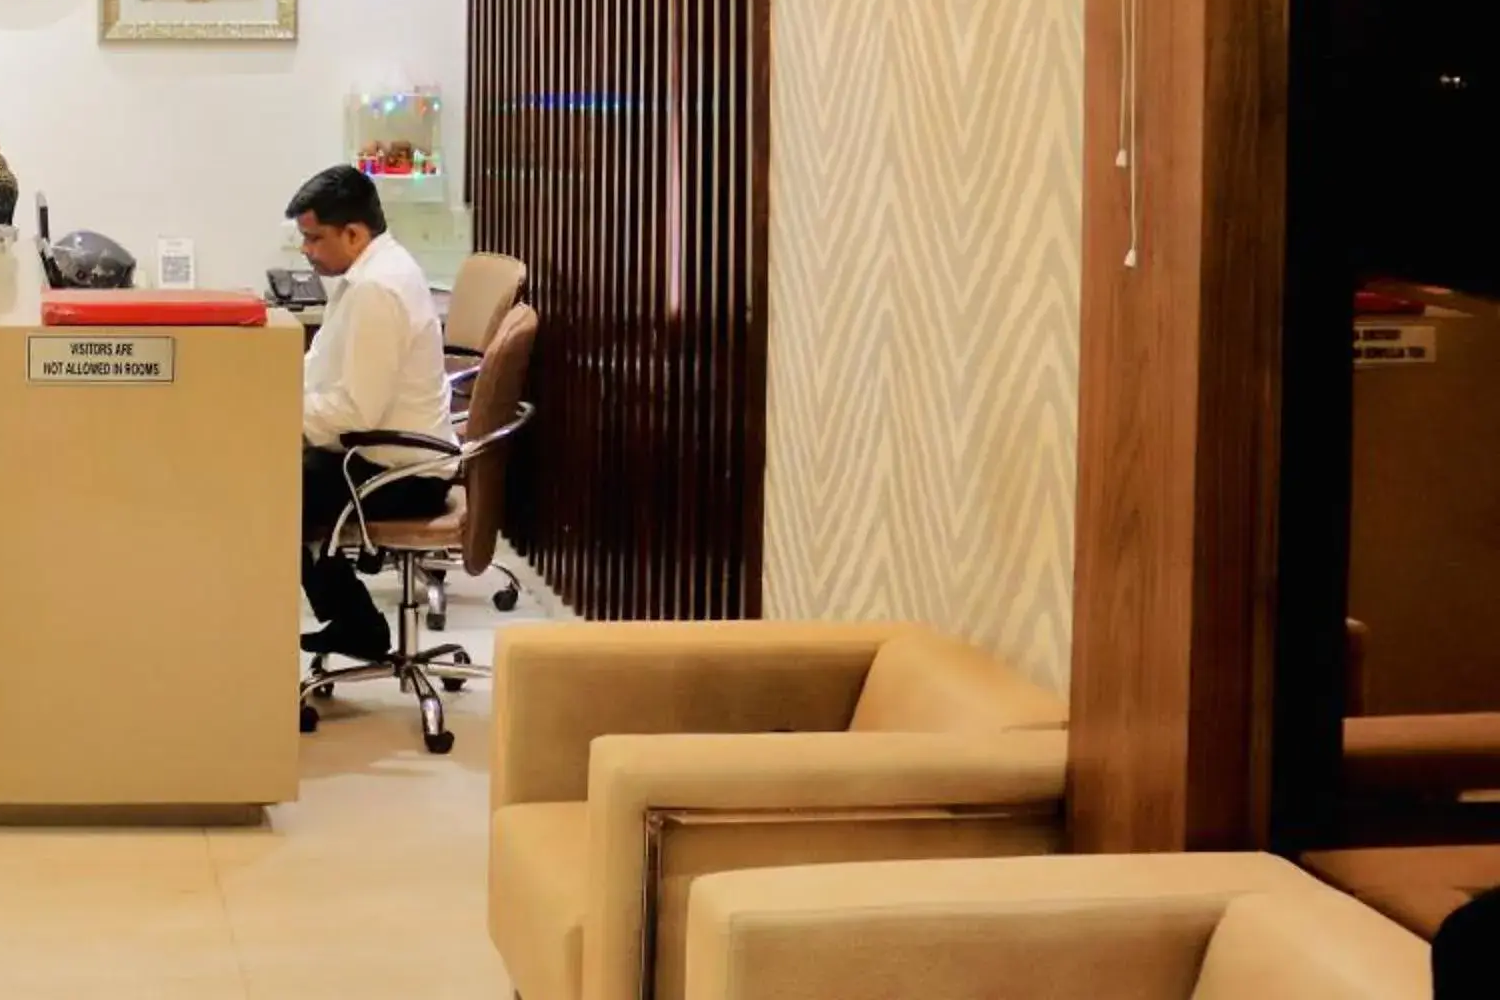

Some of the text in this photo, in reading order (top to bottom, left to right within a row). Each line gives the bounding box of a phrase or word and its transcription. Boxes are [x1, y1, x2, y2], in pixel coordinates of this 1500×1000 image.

[70, 343, 134, 356] VISITORS ARE
[43, 362, 160, 375] NOT ALLOWED IN ROOMS
